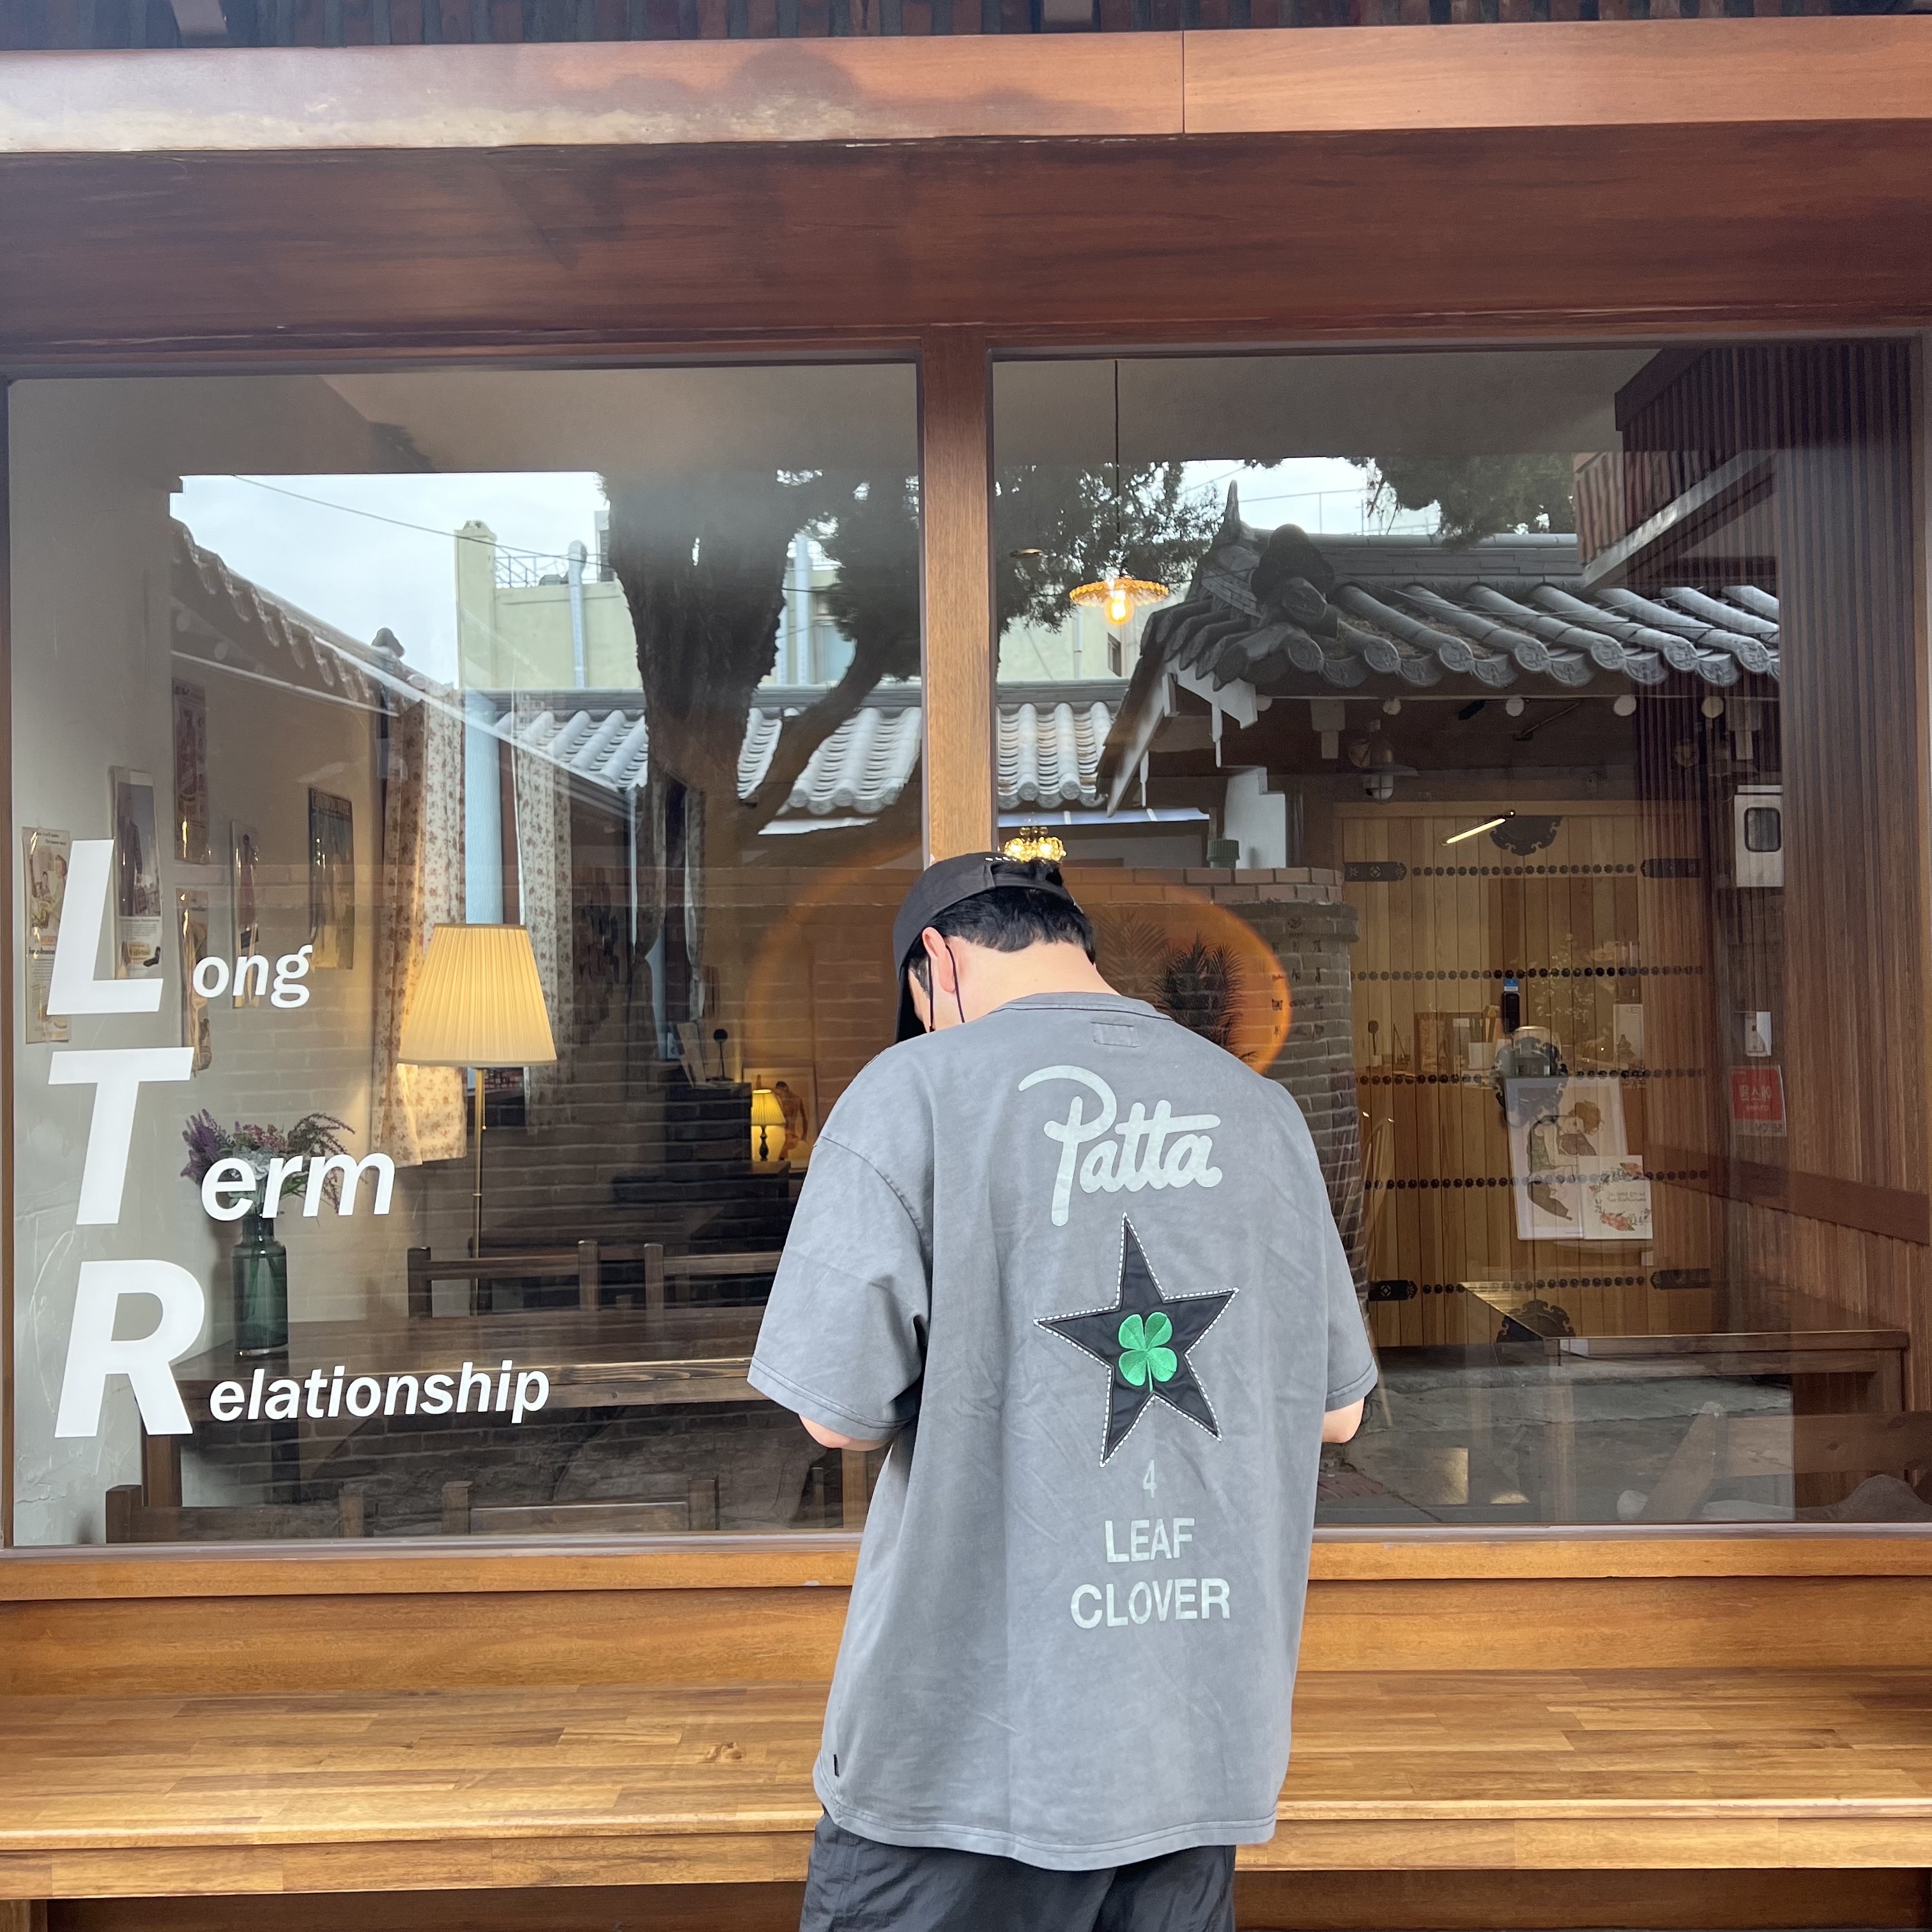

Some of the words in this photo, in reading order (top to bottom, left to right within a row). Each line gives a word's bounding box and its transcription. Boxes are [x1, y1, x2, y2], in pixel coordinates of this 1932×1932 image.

[1018, 1065, 1223, 1227] Patta
[1142, 1459, 1158, 1499] 4
[1105, 1517, 1195, 1563] LEAF
[1070, 1577, 1230, 1629] CLOVER
